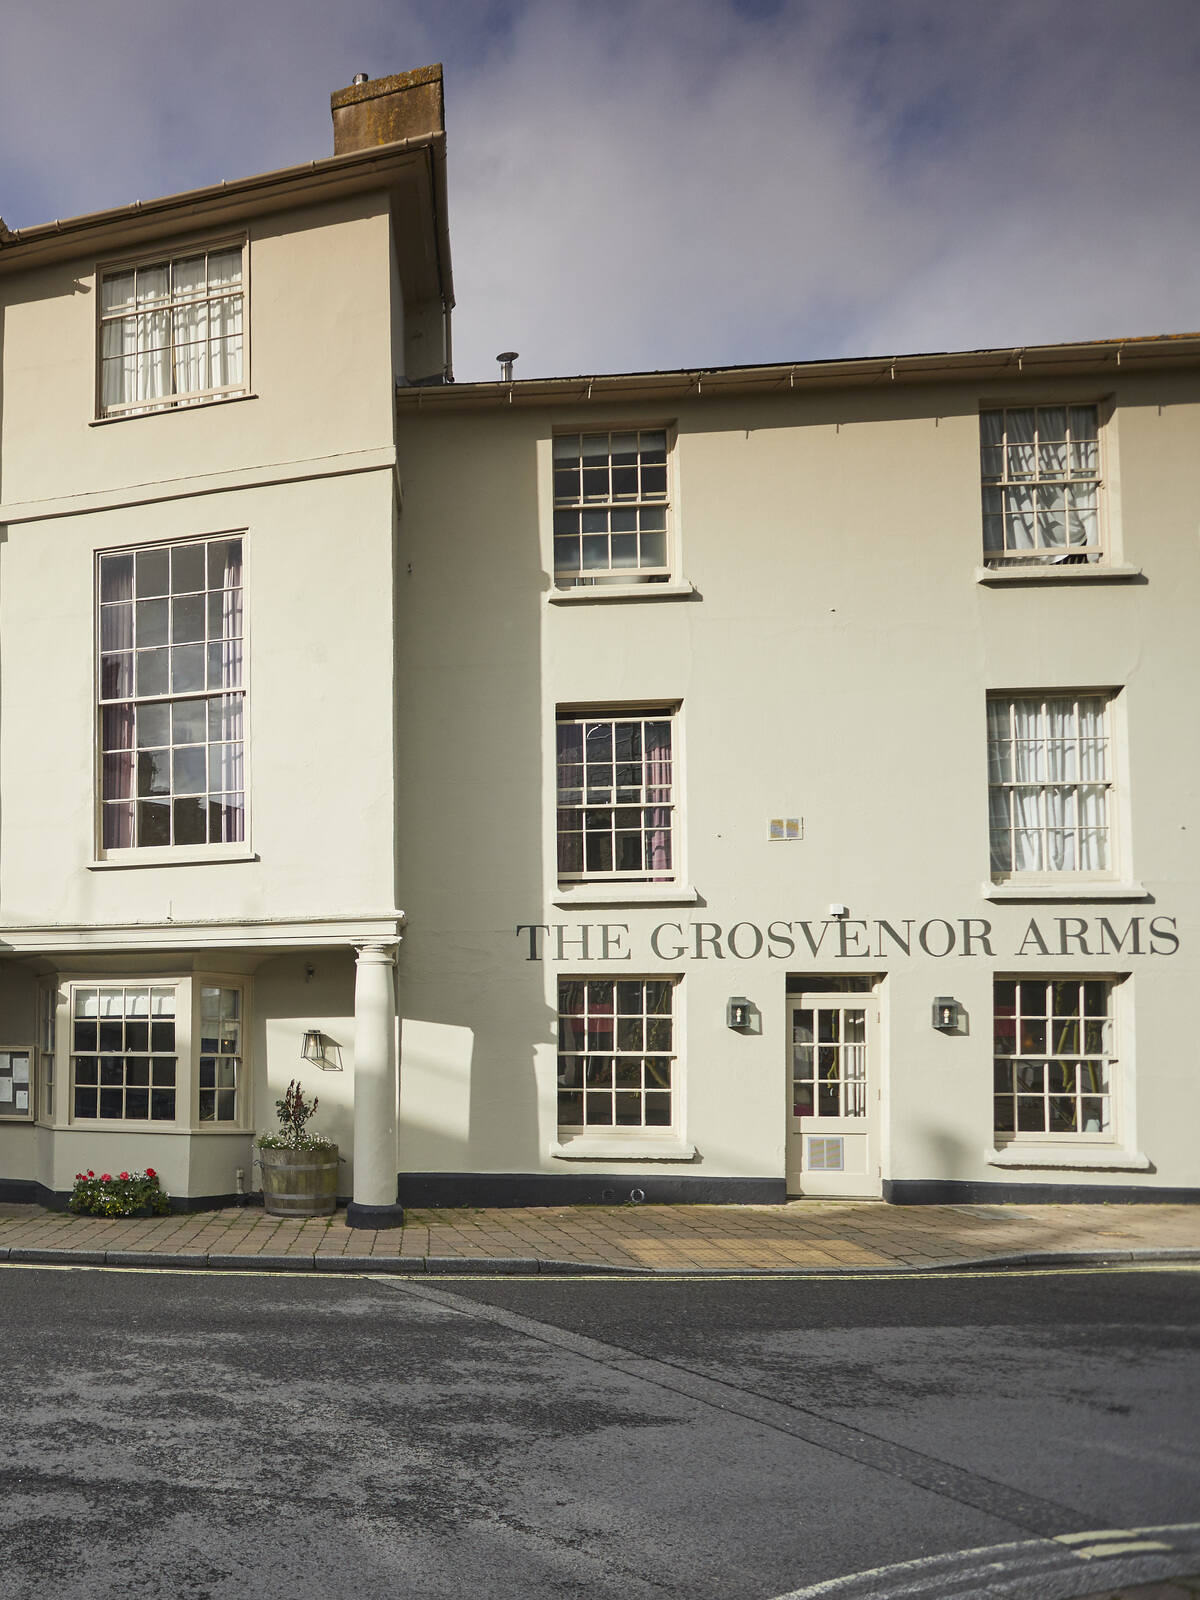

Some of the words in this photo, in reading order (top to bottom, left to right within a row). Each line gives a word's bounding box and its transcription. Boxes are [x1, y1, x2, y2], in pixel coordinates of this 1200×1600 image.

[516, 923, 633, 962] THE
[650, 917, 997, 960] GROSVENOR
[1014, 915, 1181, 957] ARMS
